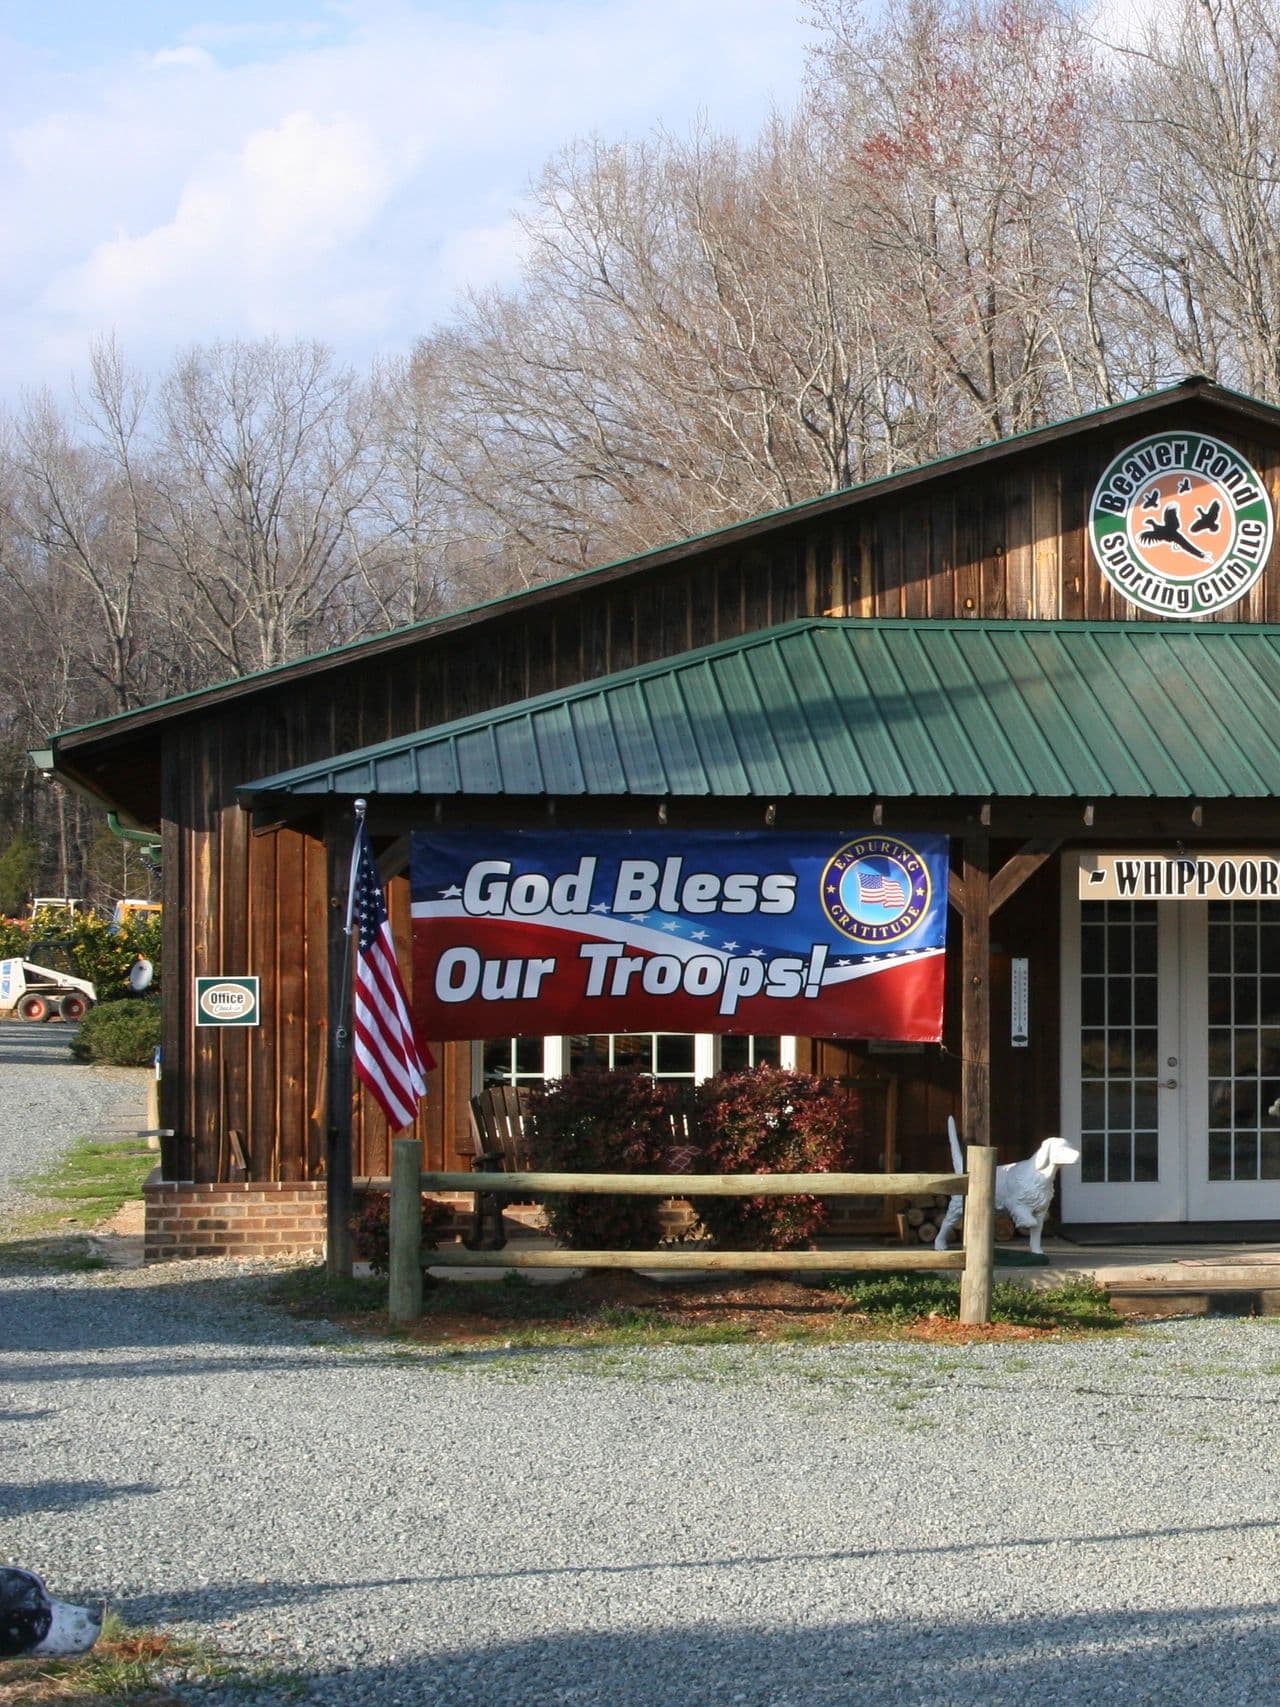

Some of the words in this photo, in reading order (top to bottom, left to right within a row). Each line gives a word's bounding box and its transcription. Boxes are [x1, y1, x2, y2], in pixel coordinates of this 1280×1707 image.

[1099, 441, 1186, 514] Beaver
[1194, 440, 1260, 507] Pond
[1103, 534, 1190, 609] Sporting
[1198, 561, 1248, 603] Club
[1236, 521, 1263, 560] LLC
[463, 857, 597, 916] God
[612, 856, 797, 915] Bless
[834, 841, 919, 871] ENDURING
[832, 905, 920, 938] GRATITUDE
[211, 992, 244, 1004] Office
[434, 947, 554, 1003] Our
[579, 942, 829, 1015] Troops!
